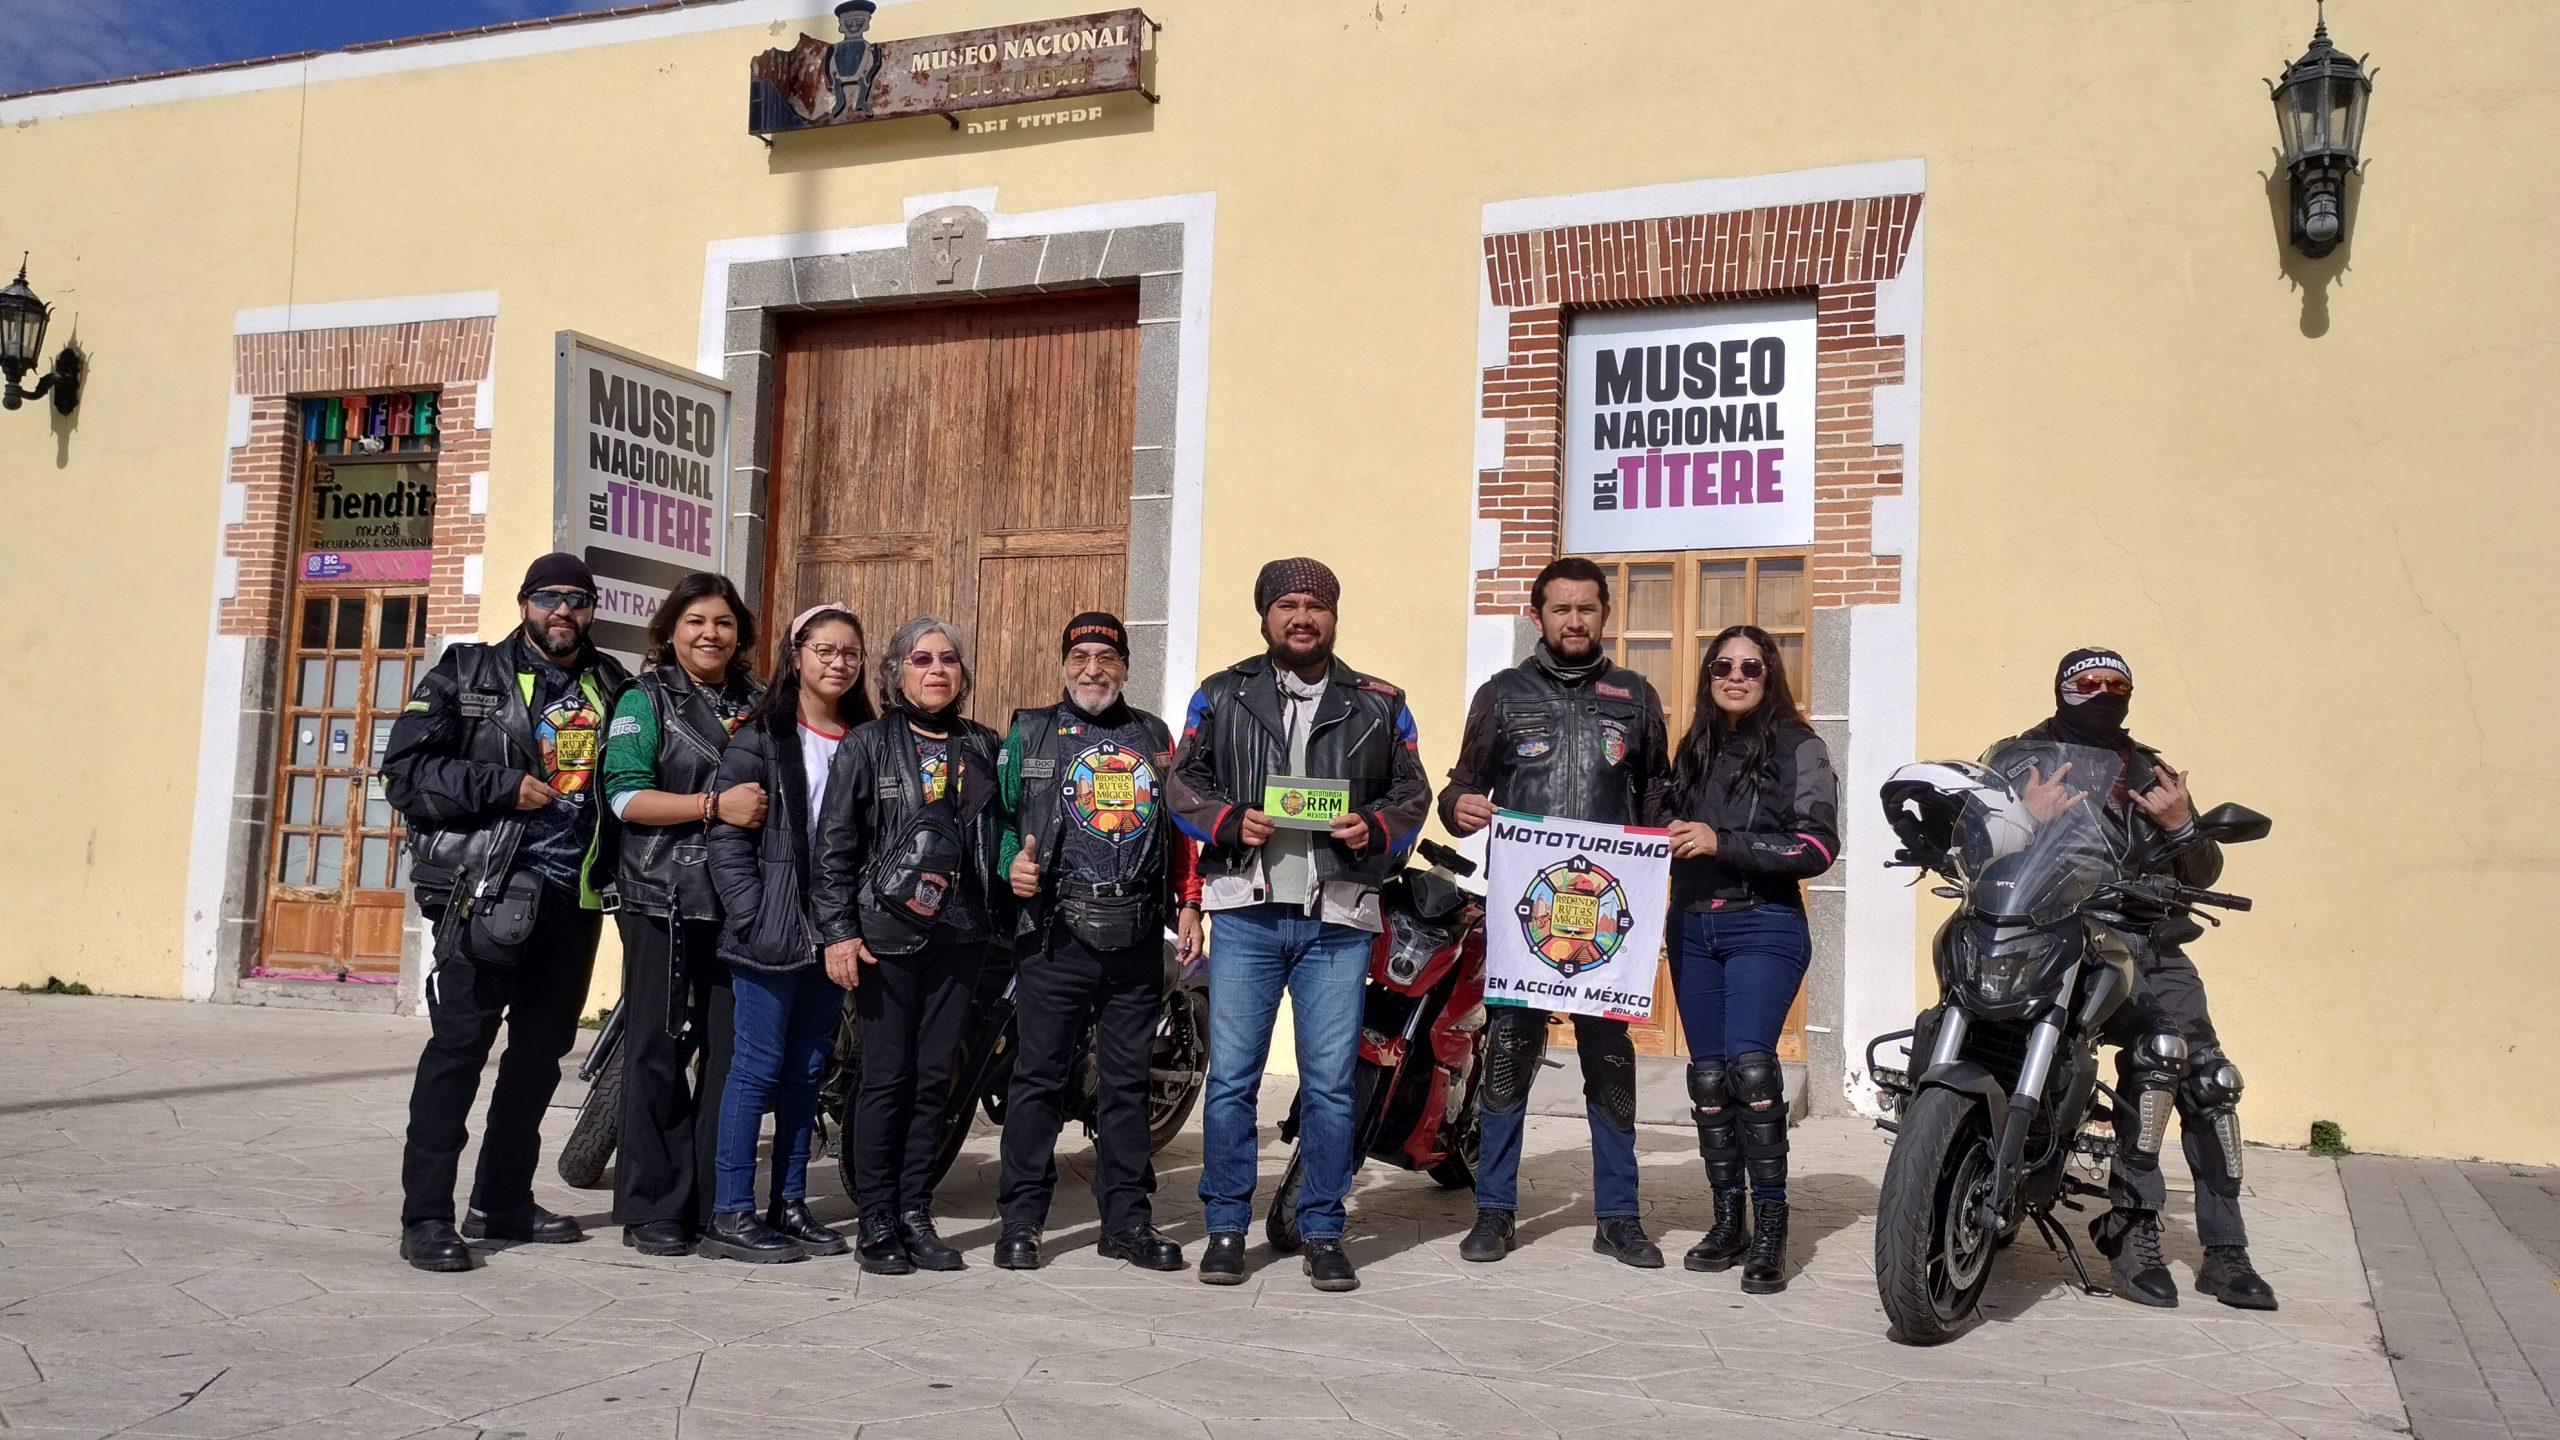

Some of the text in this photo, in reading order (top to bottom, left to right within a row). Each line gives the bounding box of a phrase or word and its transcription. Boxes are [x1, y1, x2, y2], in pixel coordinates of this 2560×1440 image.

[911, 26, 1128, 72] MUSEO NACIONAL
[1595, 336, 1786, 406] MUSEO
[589, 368, 716, 458] MUSEO
[1594, 402, 1785, 451] NACIONAL
[313, 464, 335, 482] La
[589, 431, 713, 501] NACIONAL
[1593, 448, 1784, 511] DEL TÍTERE
[589, 481, 713, 557] DEL TÍTERE
[313, 540, 370, 550] RECUERDOS
[323, 555, 338, 565] SC
[596, 586, 666, 617] ENTRA
[1071, 625, 1118, 641] CHOPPERS
[1103, 744, 1114, 752] N
[1151, 788, 1159, 796] E
[1307, 790, 1342, 798] MOTOTURISTA
[1307, 797, 1342, 811] RRM
[1494, 822, 1670, 859] MOTOTURISMO
[1573, 859, 1586, 869] N
[1518, 905, 1530, 915] O
[1619, 917, 1630, 926] E
[1563, 962, 1574, 973] S
[1488, 977, 1652, 1008] EN ACCIÓN MÉXICO
